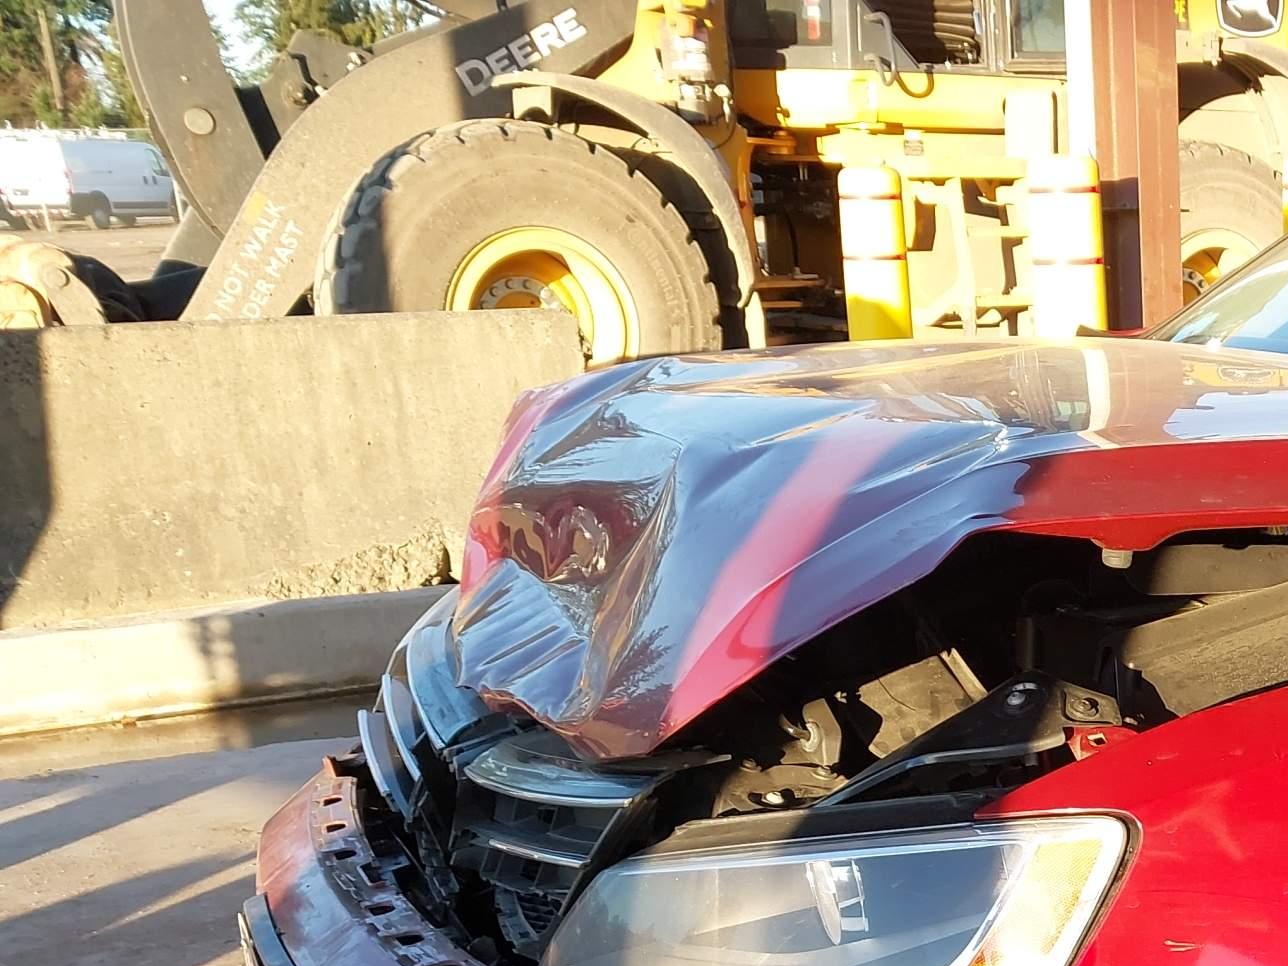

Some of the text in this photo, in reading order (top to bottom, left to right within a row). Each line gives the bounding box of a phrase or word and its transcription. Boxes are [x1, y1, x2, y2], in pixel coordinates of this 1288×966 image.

[455, 7, 588, 97] DEERE
[213, 261, 249, 312] NOT
[239, 199, 286, 260] WALK
[265, 219, 304, 279] MAST
